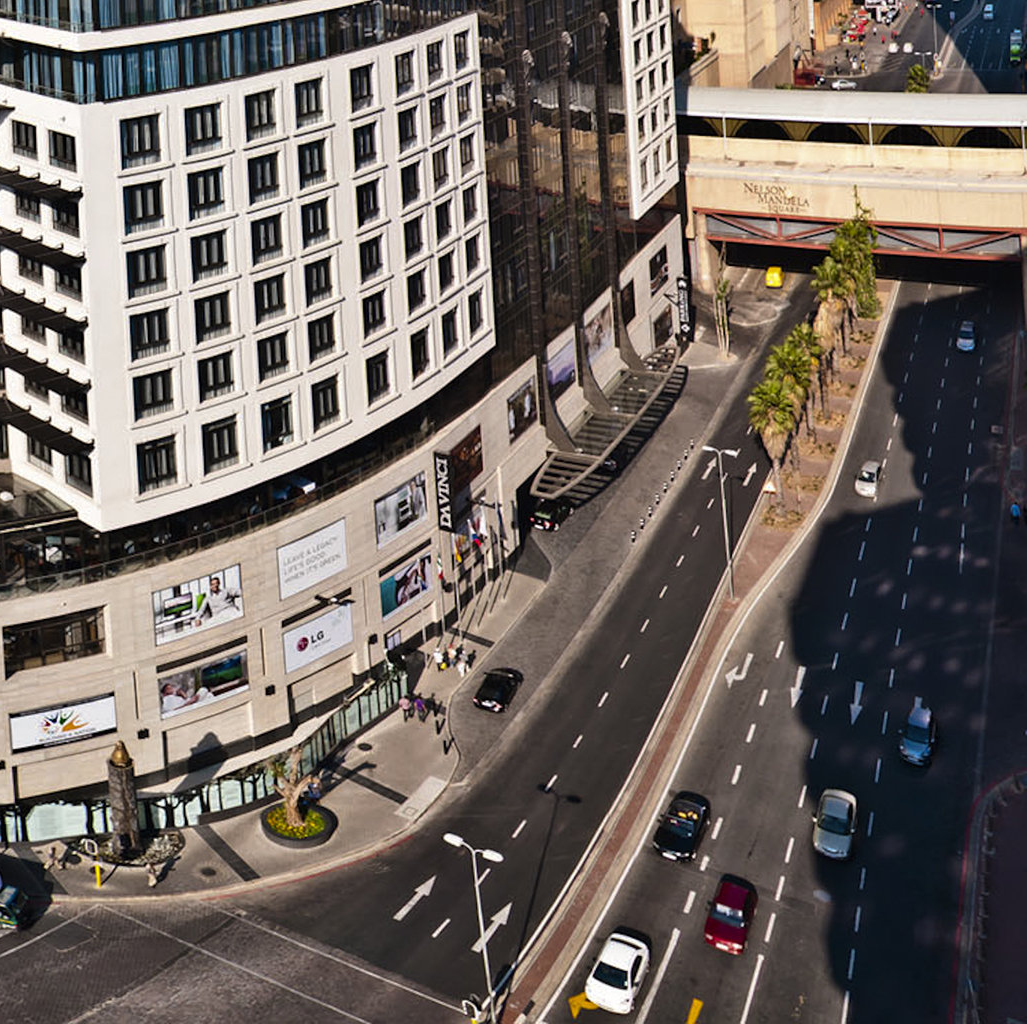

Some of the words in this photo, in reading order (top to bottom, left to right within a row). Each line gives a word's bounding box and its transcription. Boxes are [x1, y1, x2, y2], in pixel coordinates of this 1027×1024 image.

[743, 182, 787, 195] NELSON
[758, 192, 810, 207] MANDELA
[768, 204, 799, 214] SQUARE
[311, 630, 324, 644] LG
